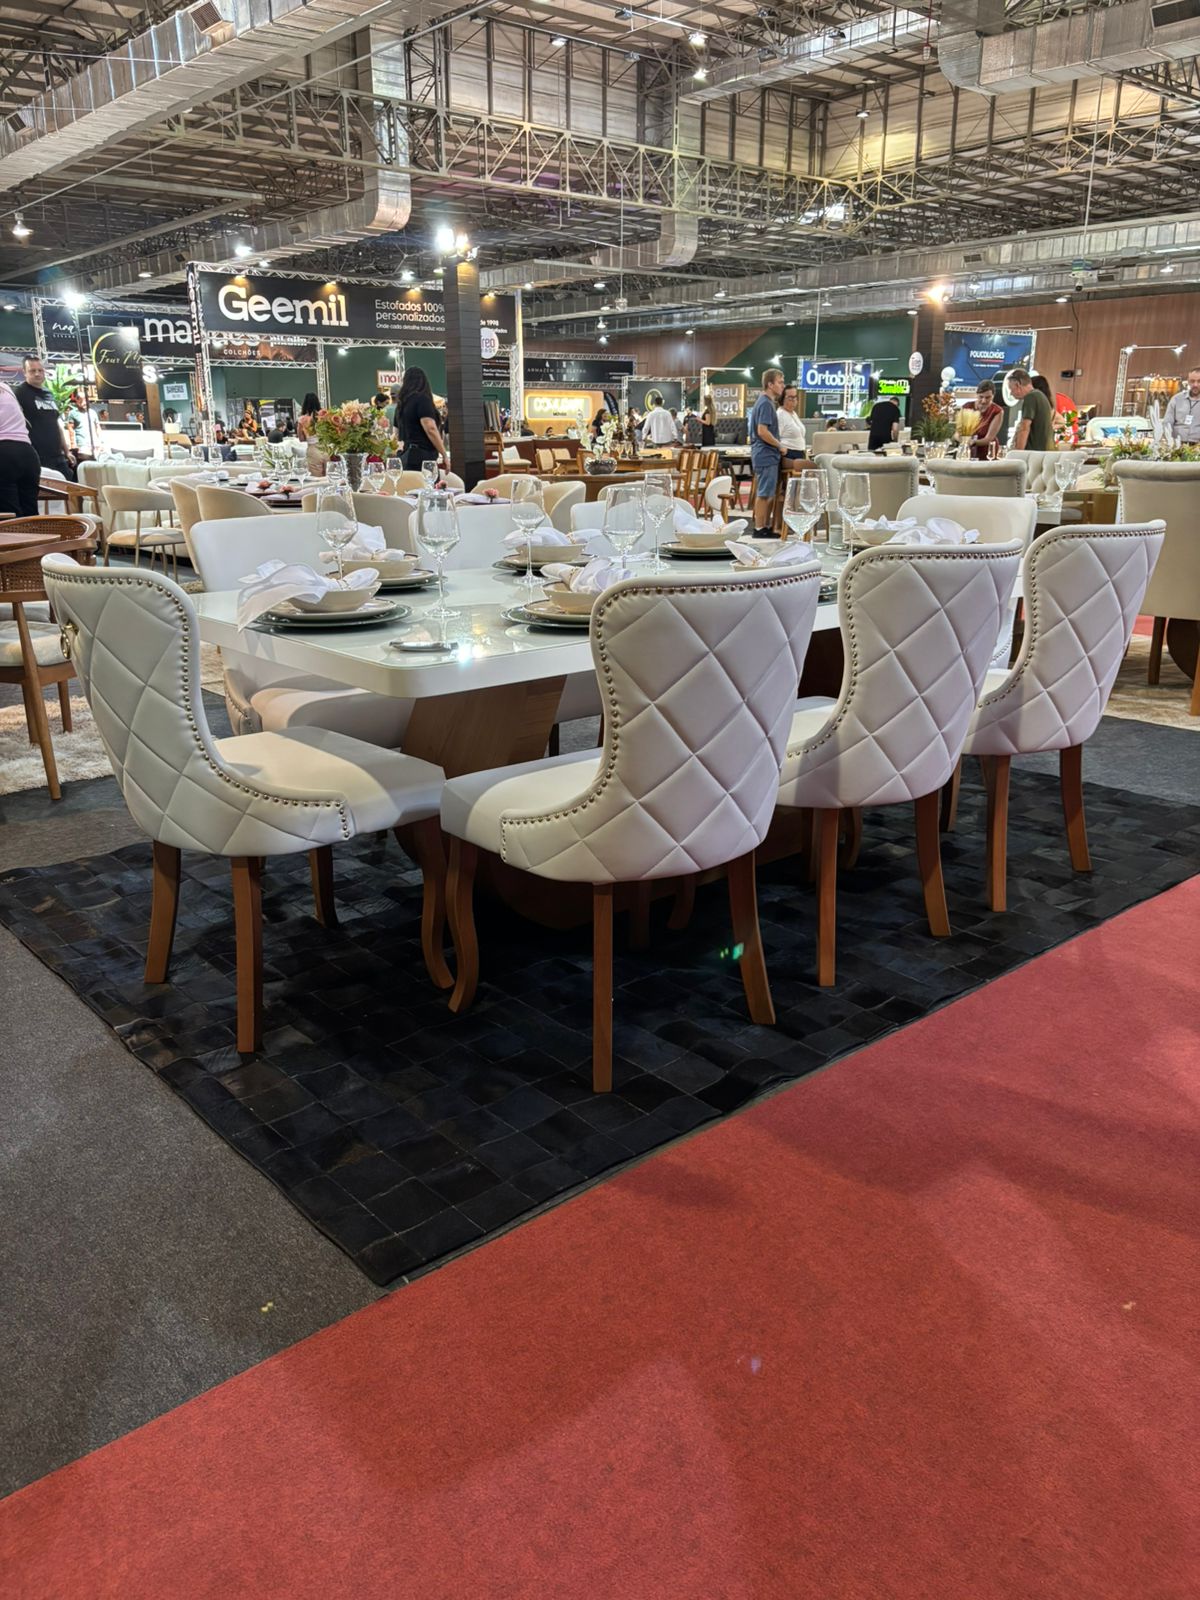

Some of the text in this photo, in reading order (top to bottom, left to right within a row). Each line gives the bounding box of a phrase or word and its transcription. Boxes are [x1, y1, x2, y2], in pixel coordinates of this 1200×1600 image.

[218, 284, 349, 326] Geemil
[375, 299, 422, 311] Estofados
[375, 311, 446, 323] personalizados
